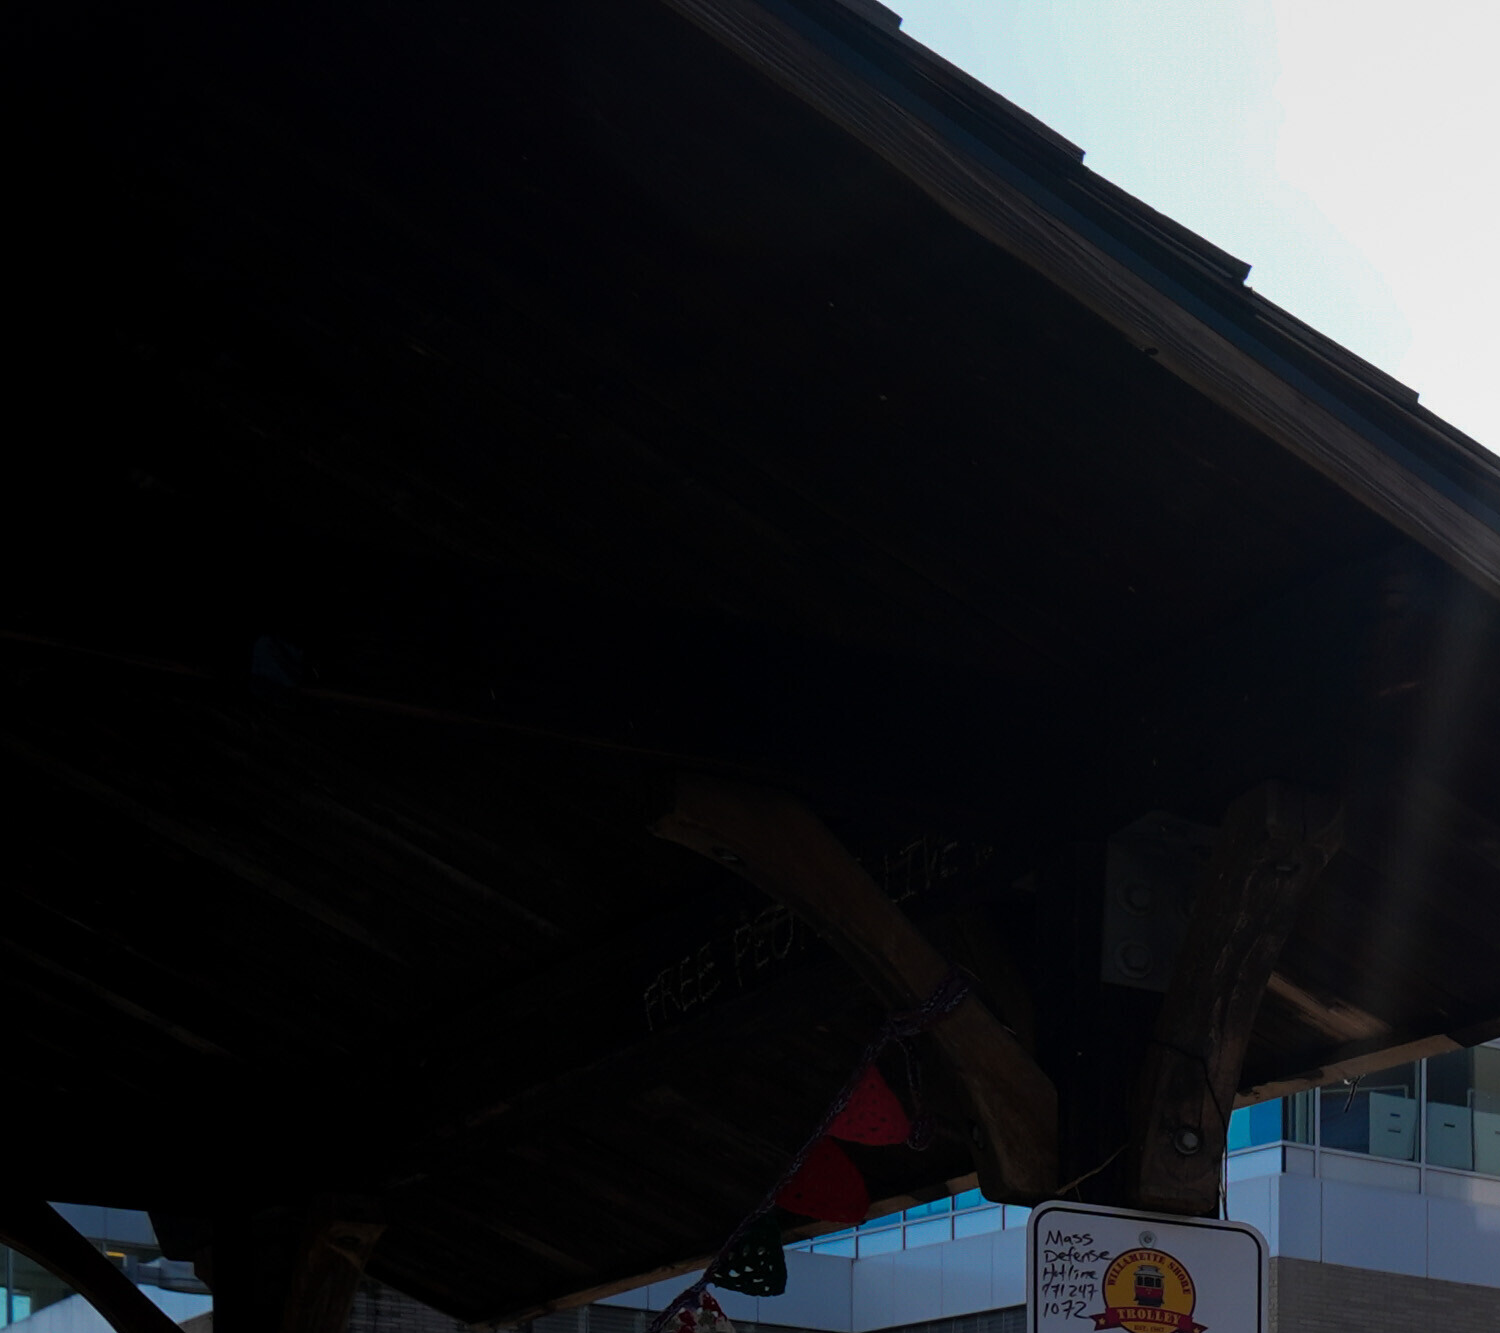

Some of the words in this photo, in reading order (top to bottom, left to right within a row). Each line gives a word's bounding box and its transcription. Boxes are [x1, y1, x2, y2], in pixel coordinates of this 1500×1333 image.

[1045, 1230, 1094, 1246] Mass
[1043, 1246, 1112, 1264] Defense
[1107, 1252, 1165, 1286] WILLAMETTE
[1167, 1262, 1191, 1295] SHORE
[1069, 1284, 1098, 1301] 247
[1044, 1300, 1091, 1320] 1072
[1116, 1308, 1181, 1326] TROLLEY
